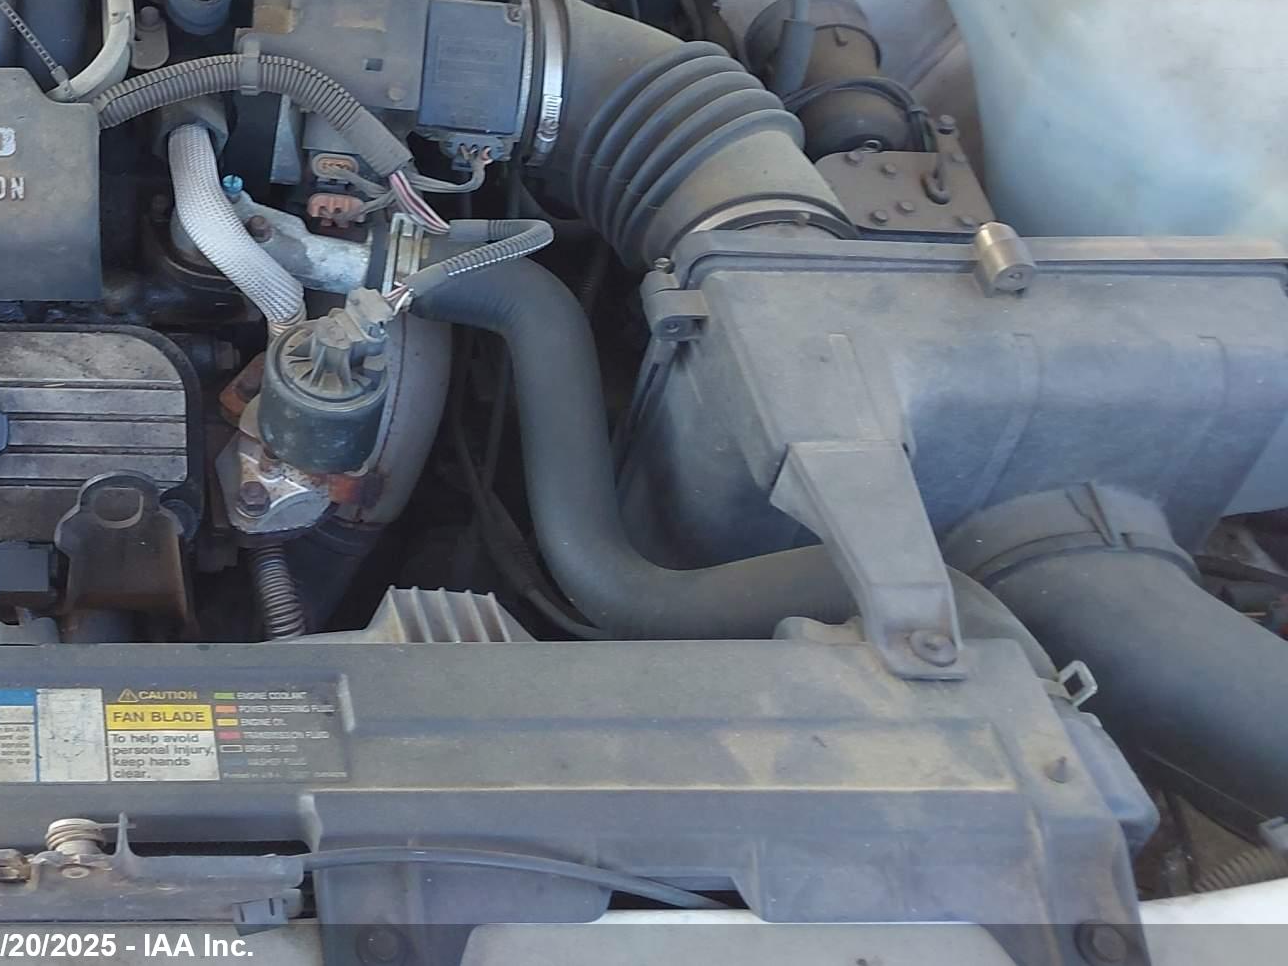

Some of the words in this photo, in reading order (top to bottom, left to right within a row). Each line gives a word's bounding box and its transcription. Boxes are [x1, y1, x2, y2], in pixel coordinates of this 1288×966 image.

[138, 690, 199, 700] CAUTION
[236, 691, 267, 700] ENGINE
[268, 691, 308, 700] COOLANT
[238, 705, 268, 713] POWER
[269, 705, 310, 713] STEERING
[113, 712, 145, 723] FAN
[151, 712, 205, 723] BLADE
[240, 718, 272, 726] ENGINE
[113, 734, 126, 743] To
[130, 734, 159, 745] help
[163, 734, 199, 743] avoid
[112, 745, 169, 756] personal
[112, 758, 145, 768] keep
[150, 757, 191, 767] hands
[113, 769, 151, 779] clear.
